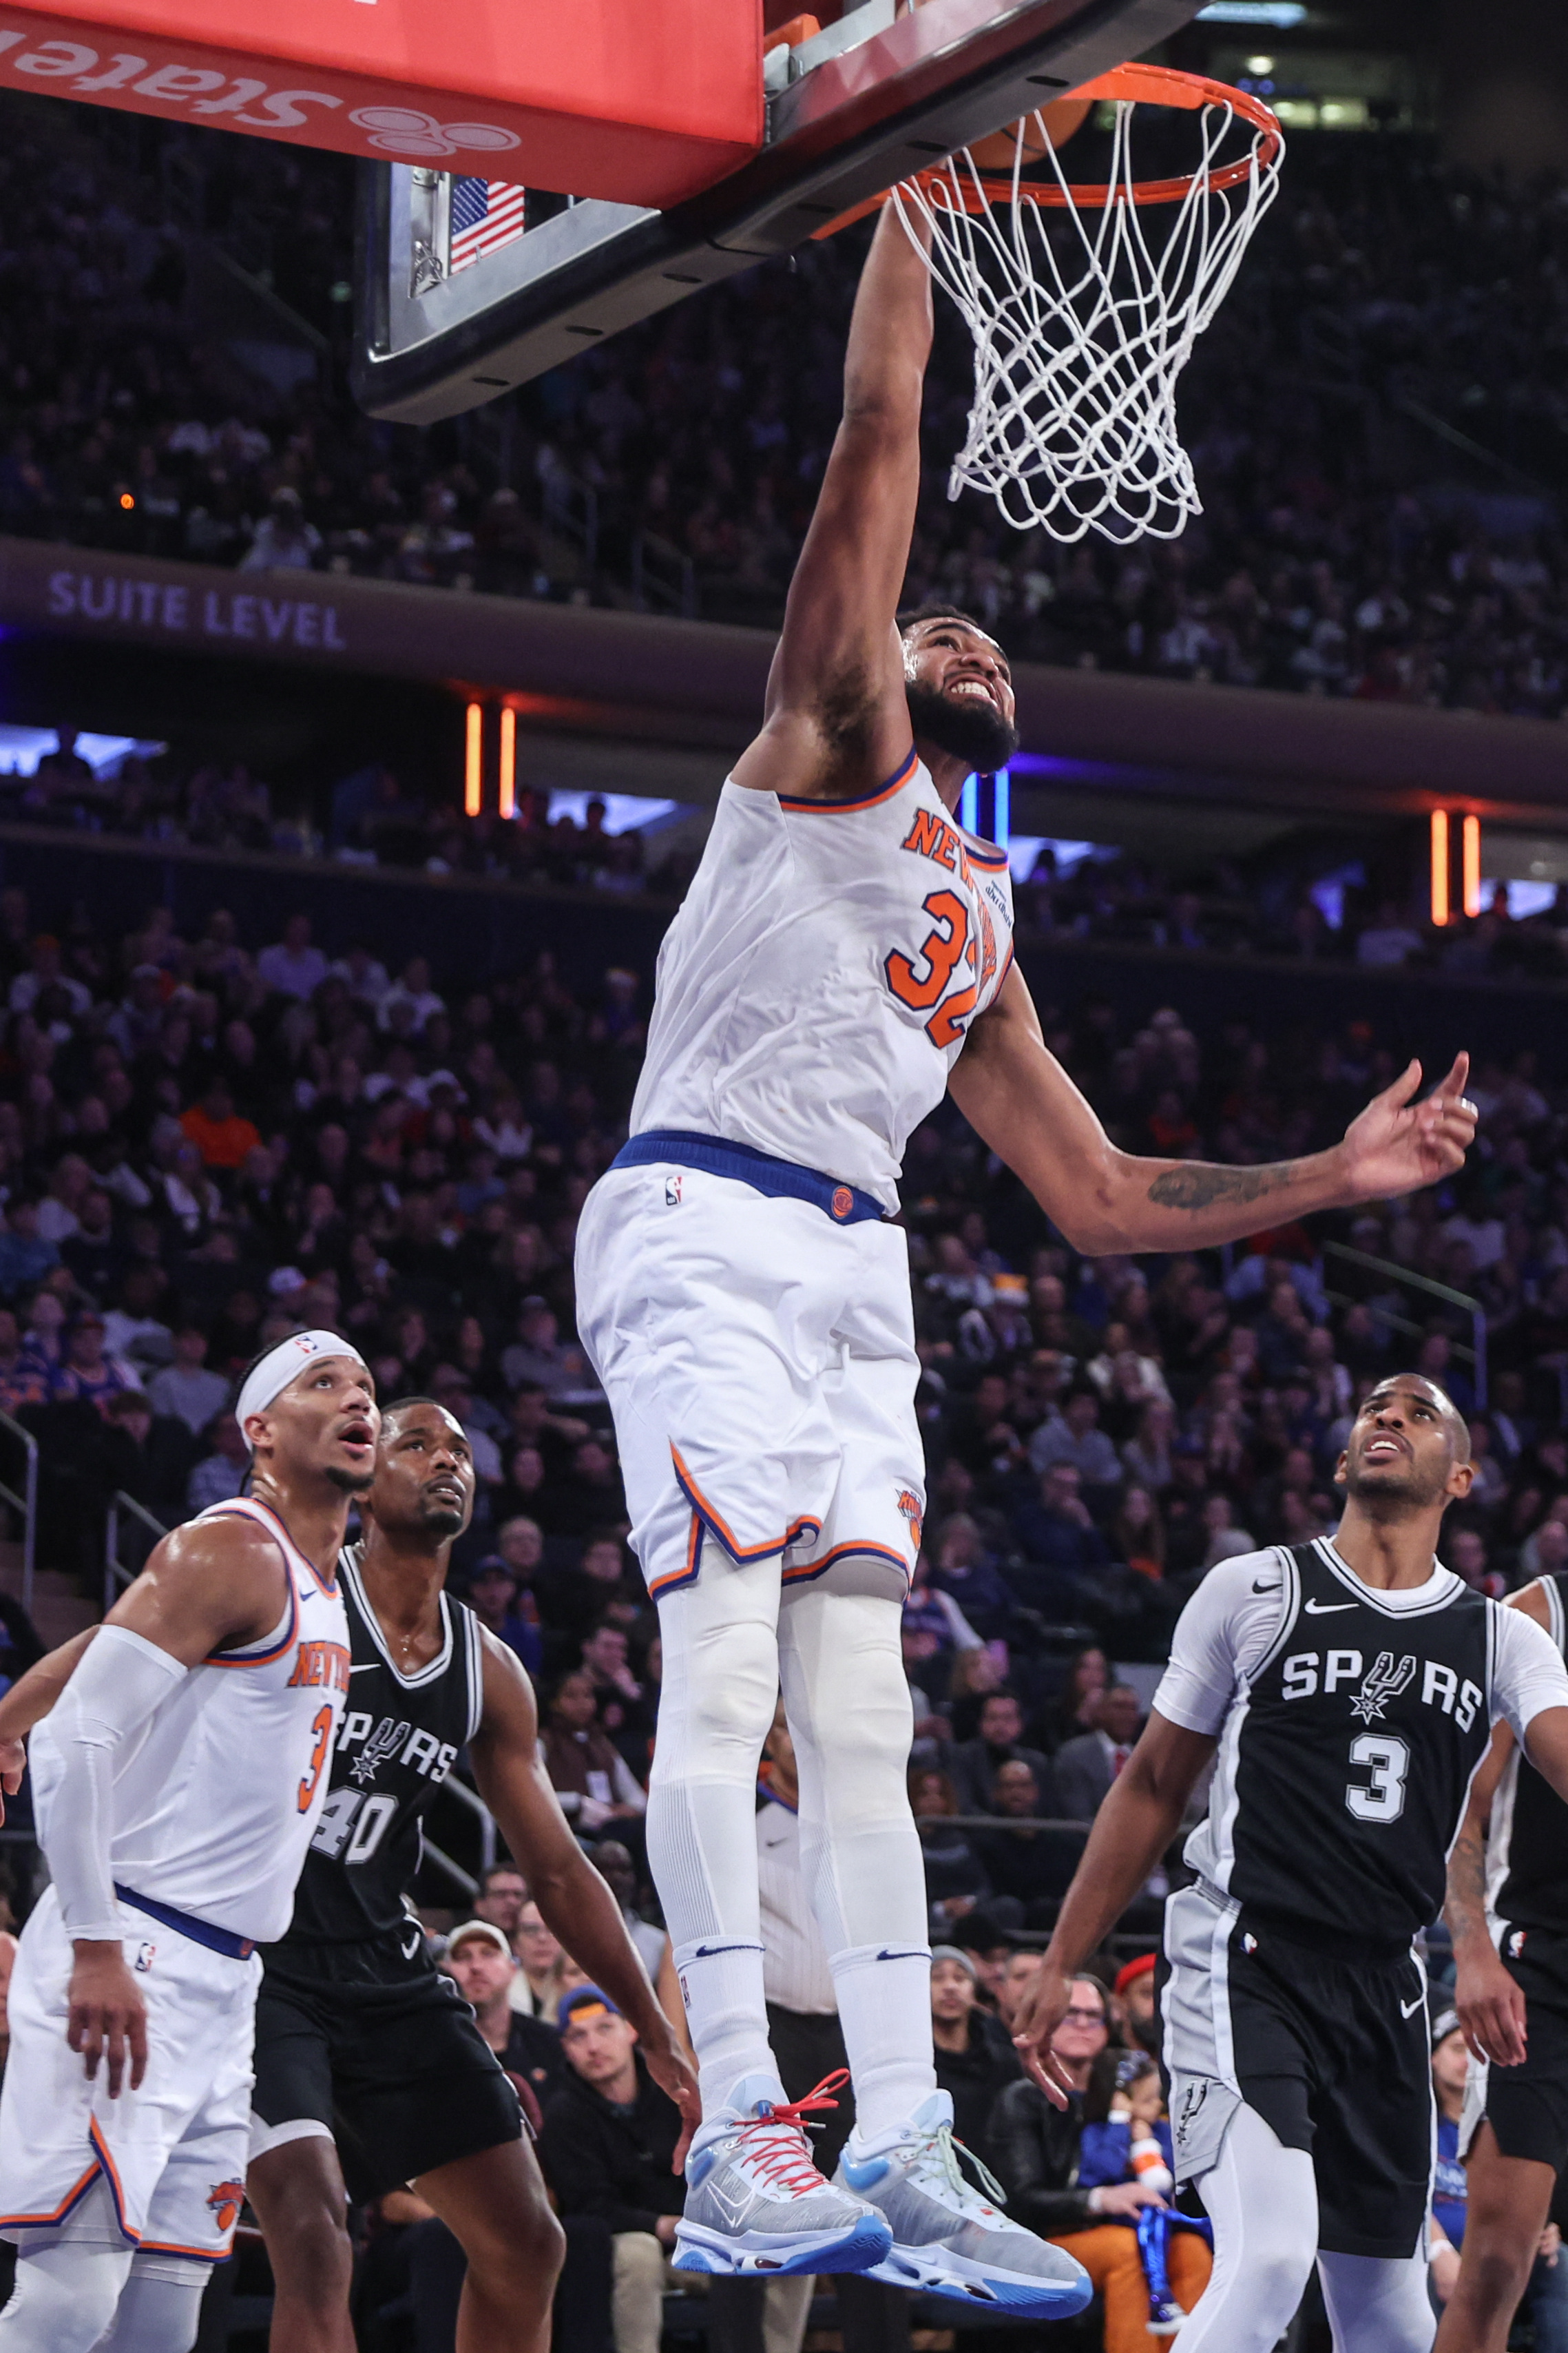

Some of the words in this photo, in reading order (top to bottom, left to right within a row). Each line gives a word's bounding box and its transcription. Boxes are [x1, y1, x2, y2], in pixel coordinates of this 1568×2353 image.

[0, 30, 344, 127] State
[48, 571, 188, 630] SUITE
[205, 590, 346, 650] LEVEL
[1282, 1650, 1483, 1734] SPURS
[297, 1703, 333, 1814] 3
[336, 1711, 458, 1785] PURS
[1346, 1732, 1410, 1824] 3
[310, 1785, 399, 1865] 40
